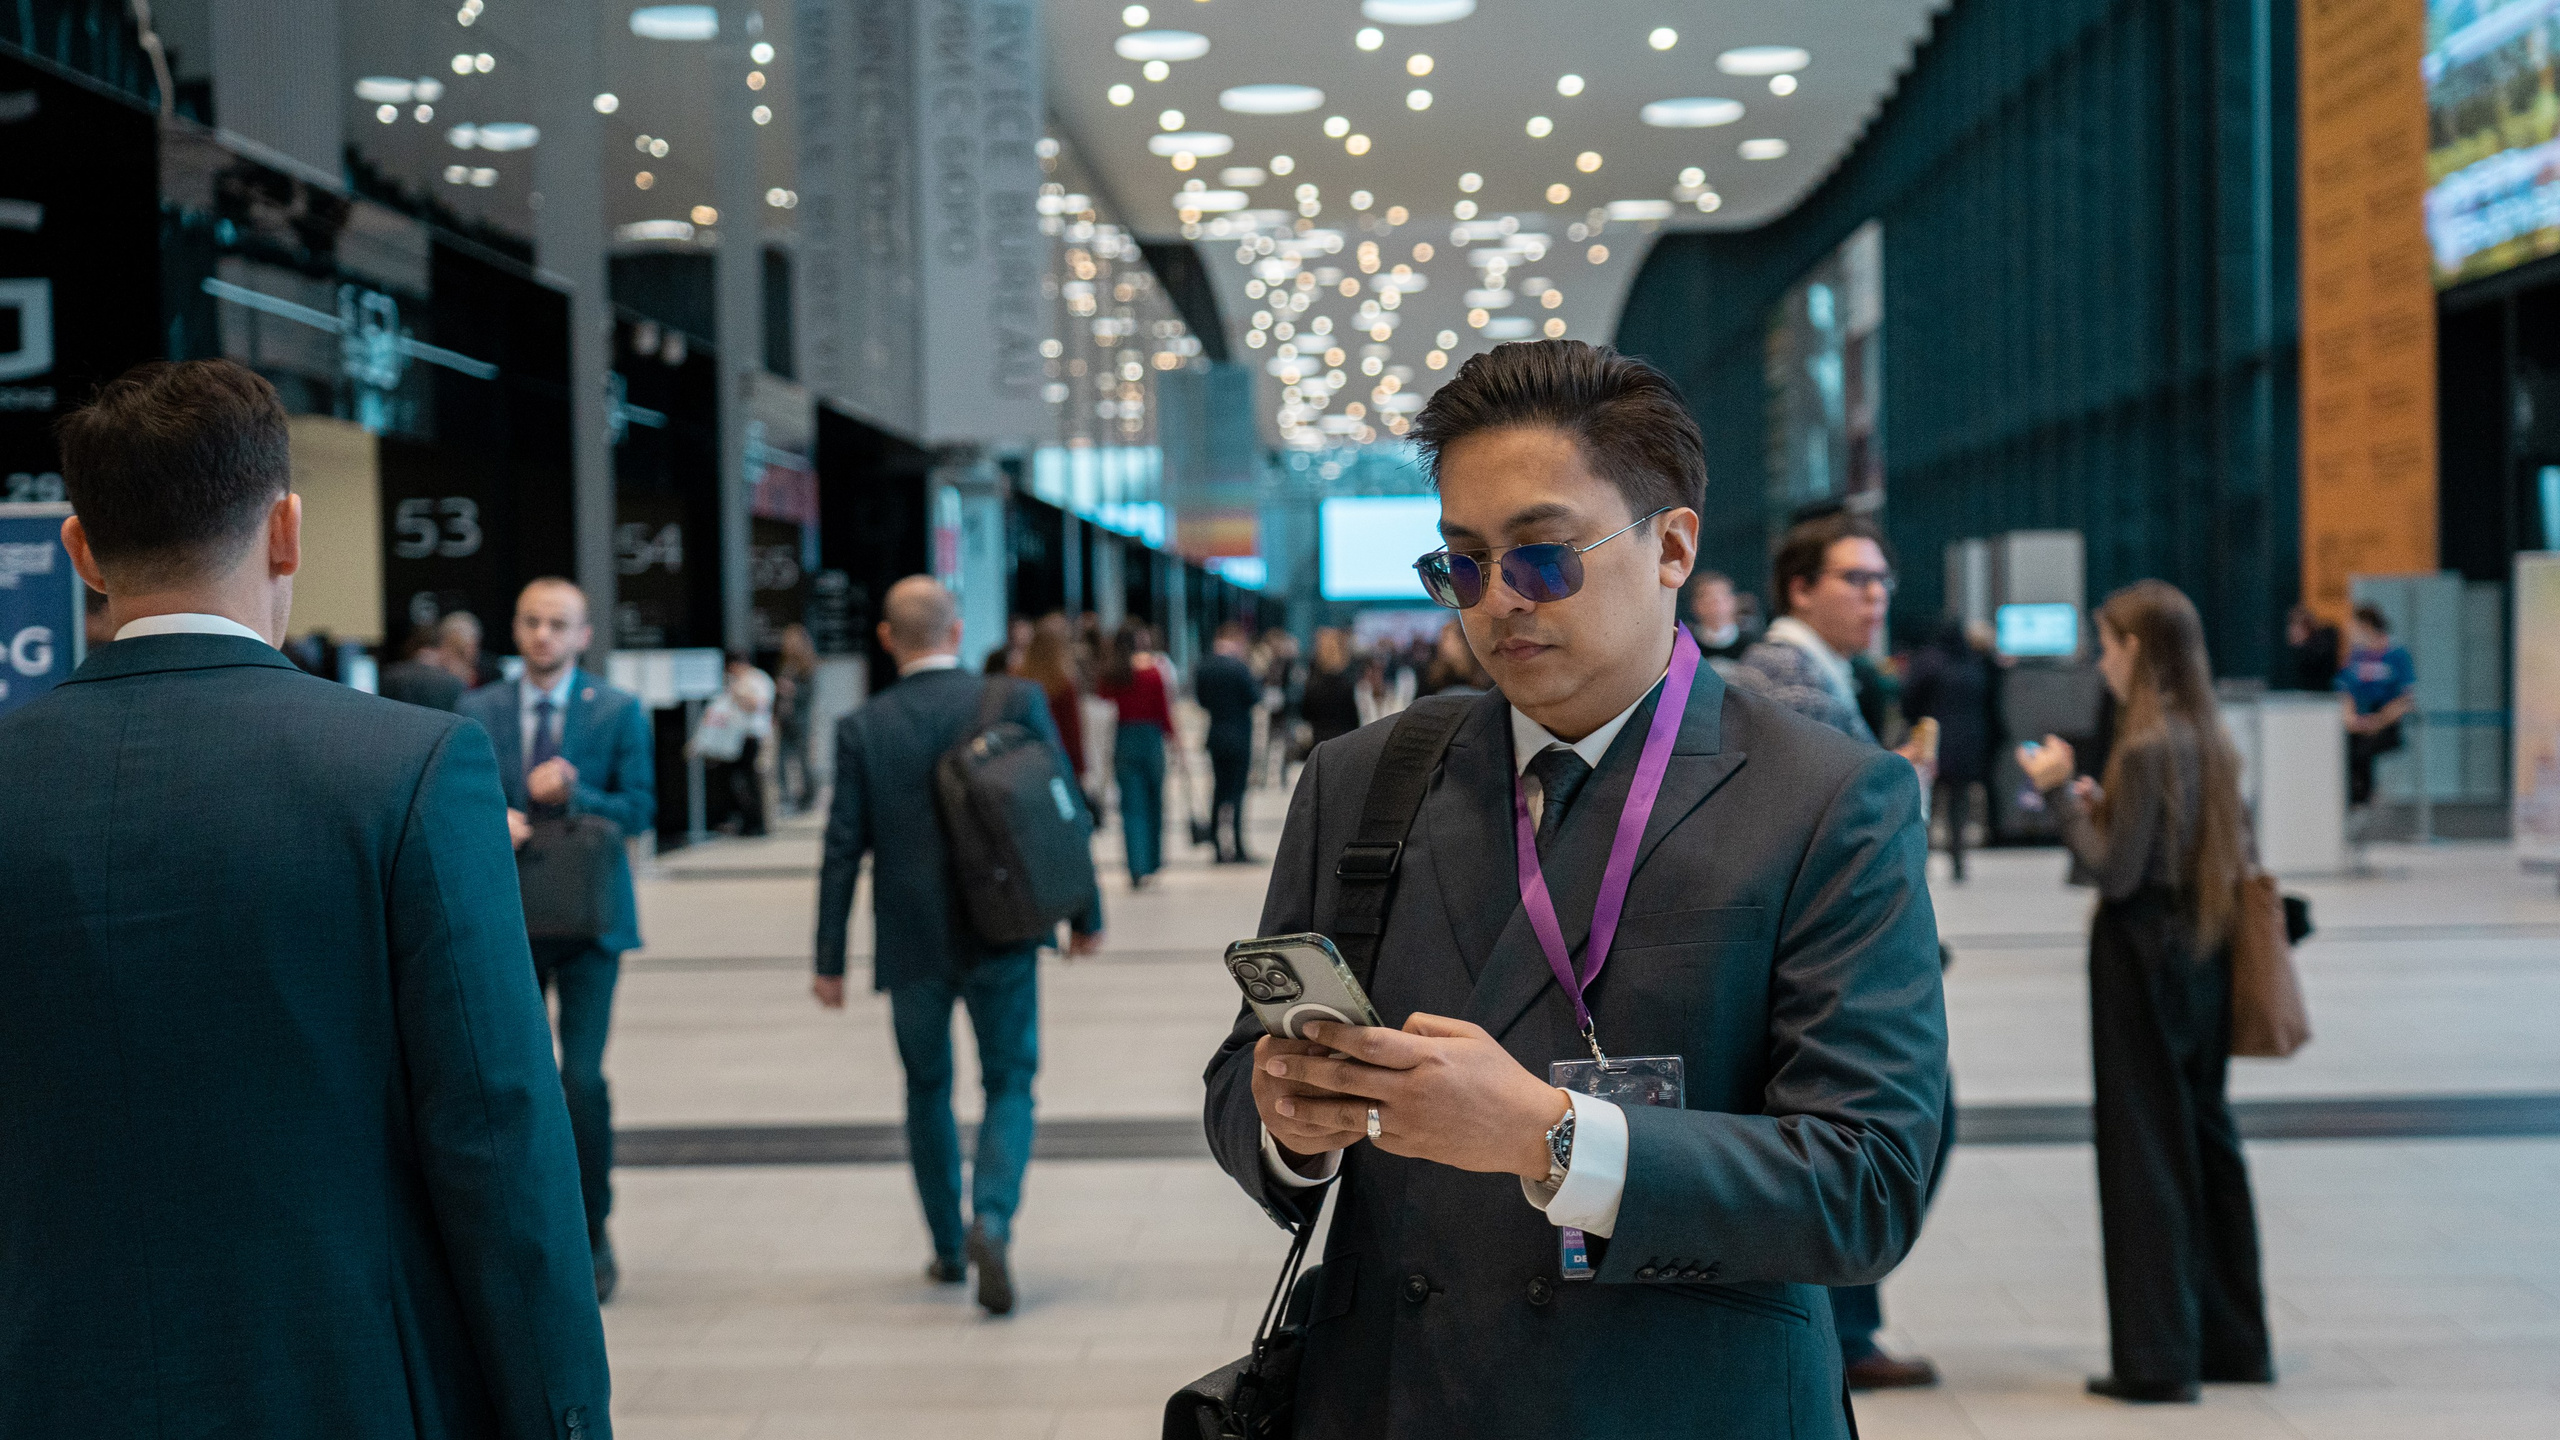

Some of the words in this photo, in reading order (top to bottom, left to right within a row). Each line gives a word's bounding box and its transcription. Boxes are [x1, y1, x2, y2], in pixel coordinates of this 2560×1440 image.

[988, 190, 1037, 401] BUREAU
[394, 496, 484, 560] 53
[614, 522, 683, 574] 54
